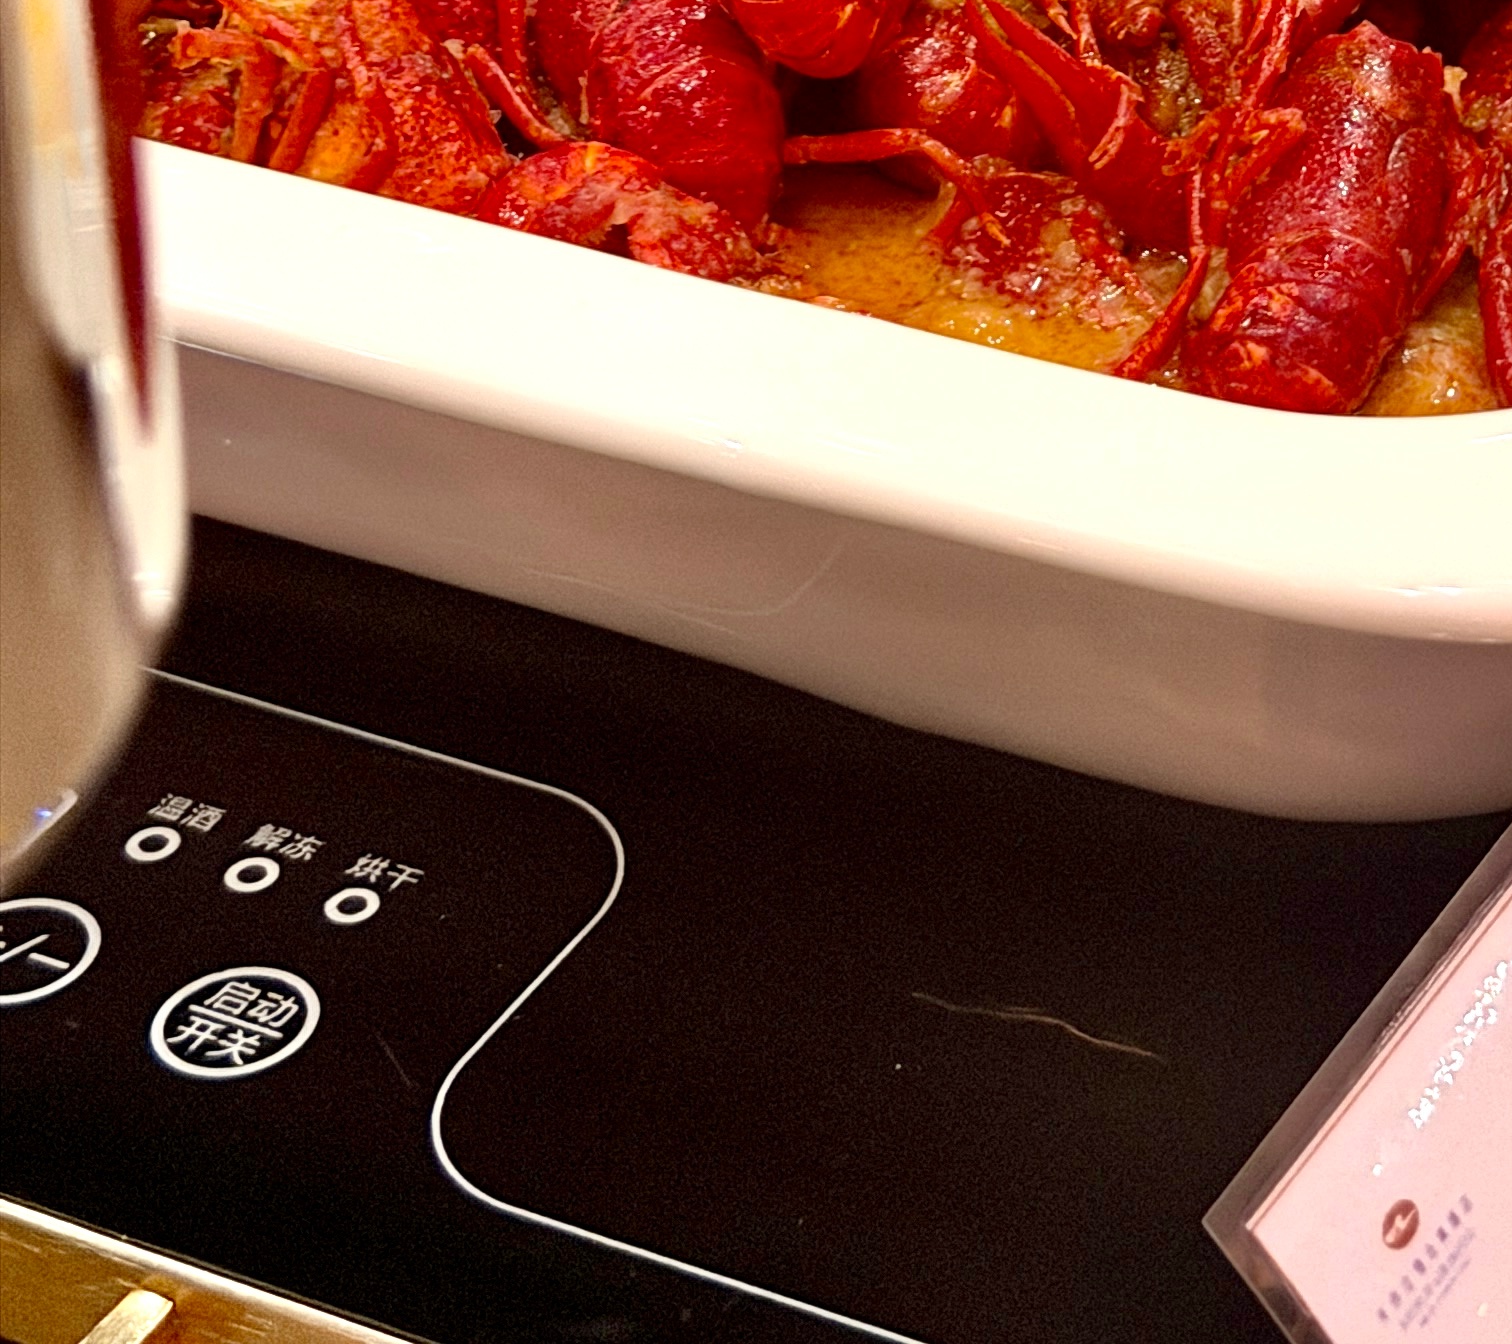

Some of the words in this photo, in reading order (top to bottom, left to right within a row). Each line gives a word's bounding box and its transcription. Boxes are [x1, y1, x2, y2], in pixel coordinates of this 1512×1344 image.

[148, 793, 227, 832] 温酒
[243, 823, 326, 860] 解冻
[345, 853, 424, 891] 烘干
[203, 980, 299, 1028] 启动
[166, 1015, 260, 1066] 开关
